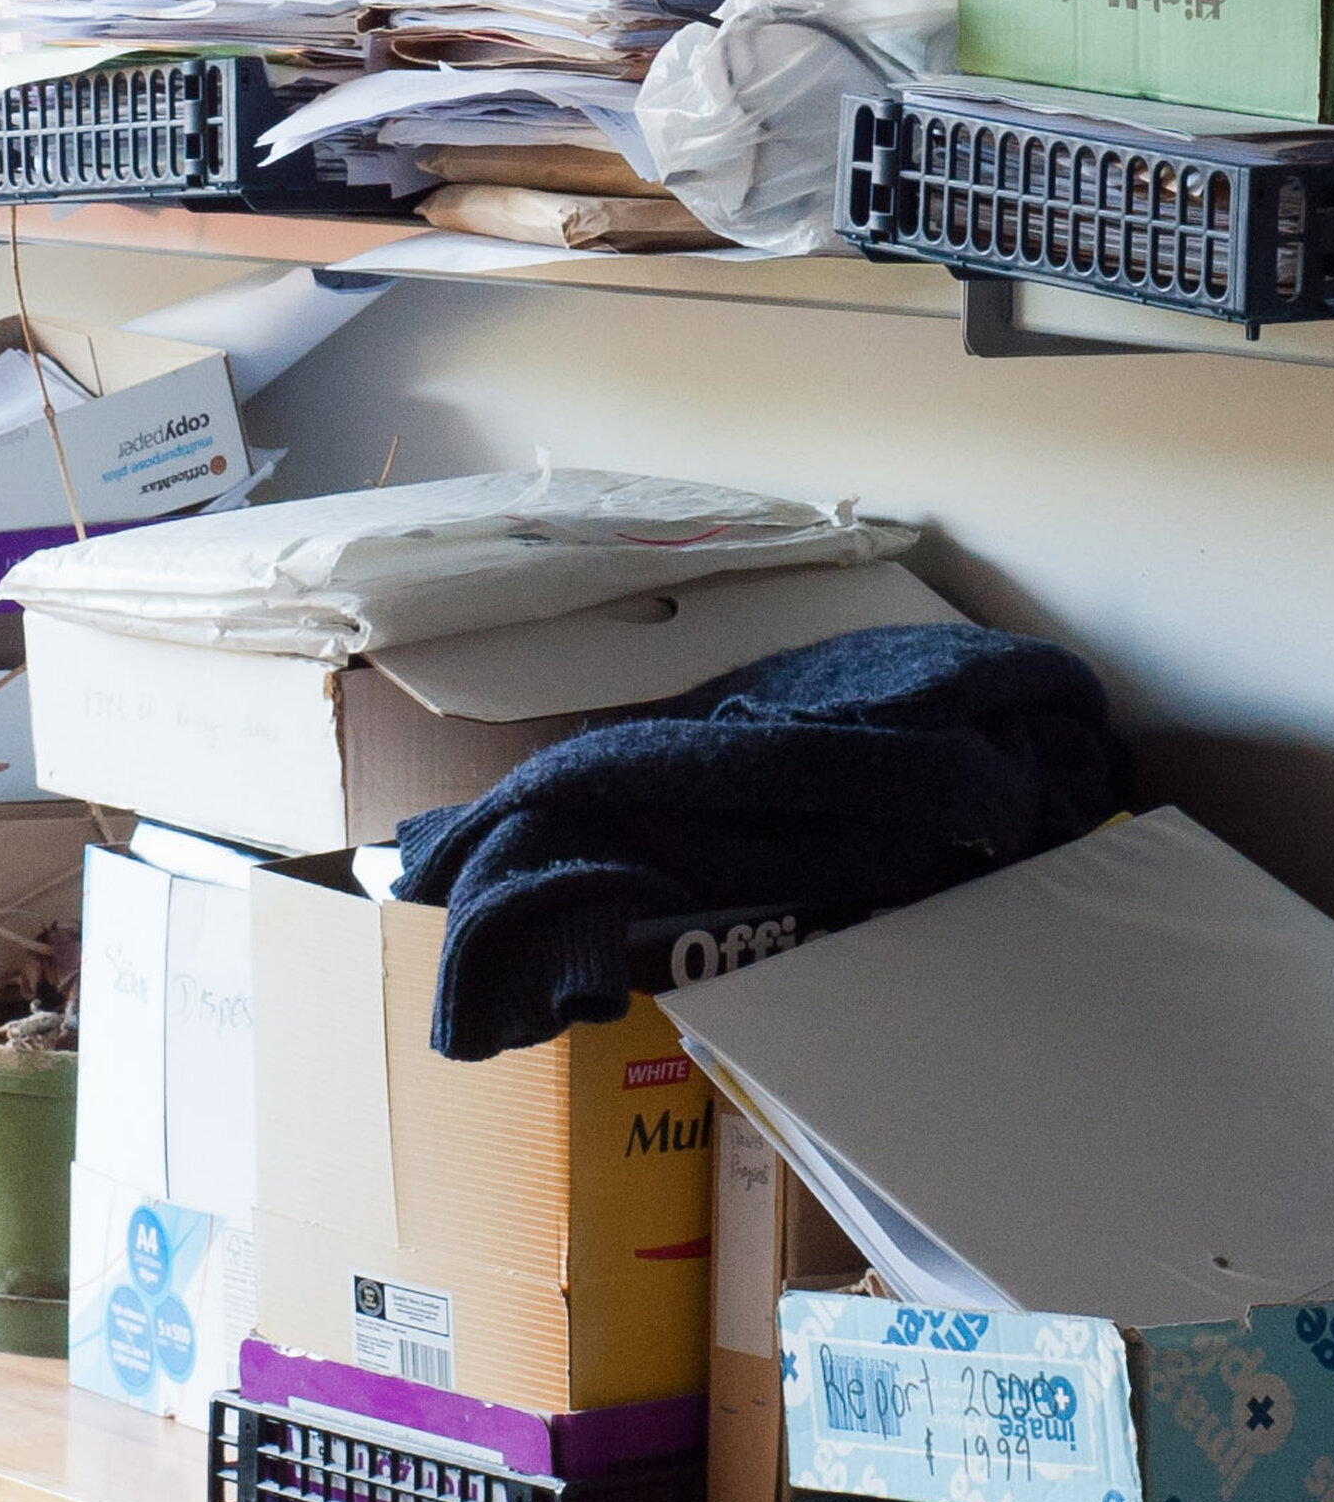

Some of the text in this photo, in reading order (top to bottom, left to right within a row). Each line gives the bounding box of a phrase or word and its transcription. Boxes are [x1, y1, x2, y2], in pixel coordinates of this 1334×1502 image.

[117, 413, 211, 460] copypaper
[101, 435, 213, 484] multipurpose plus
[139, 463, 210, 495] OfficeMax
[628, 1058, 688, 1084] WHITE
[136, 1223, 159, 1256] A4
[998, 1412, 1077, 1451] image
[962, 1434, 1033, 1482] 1999
